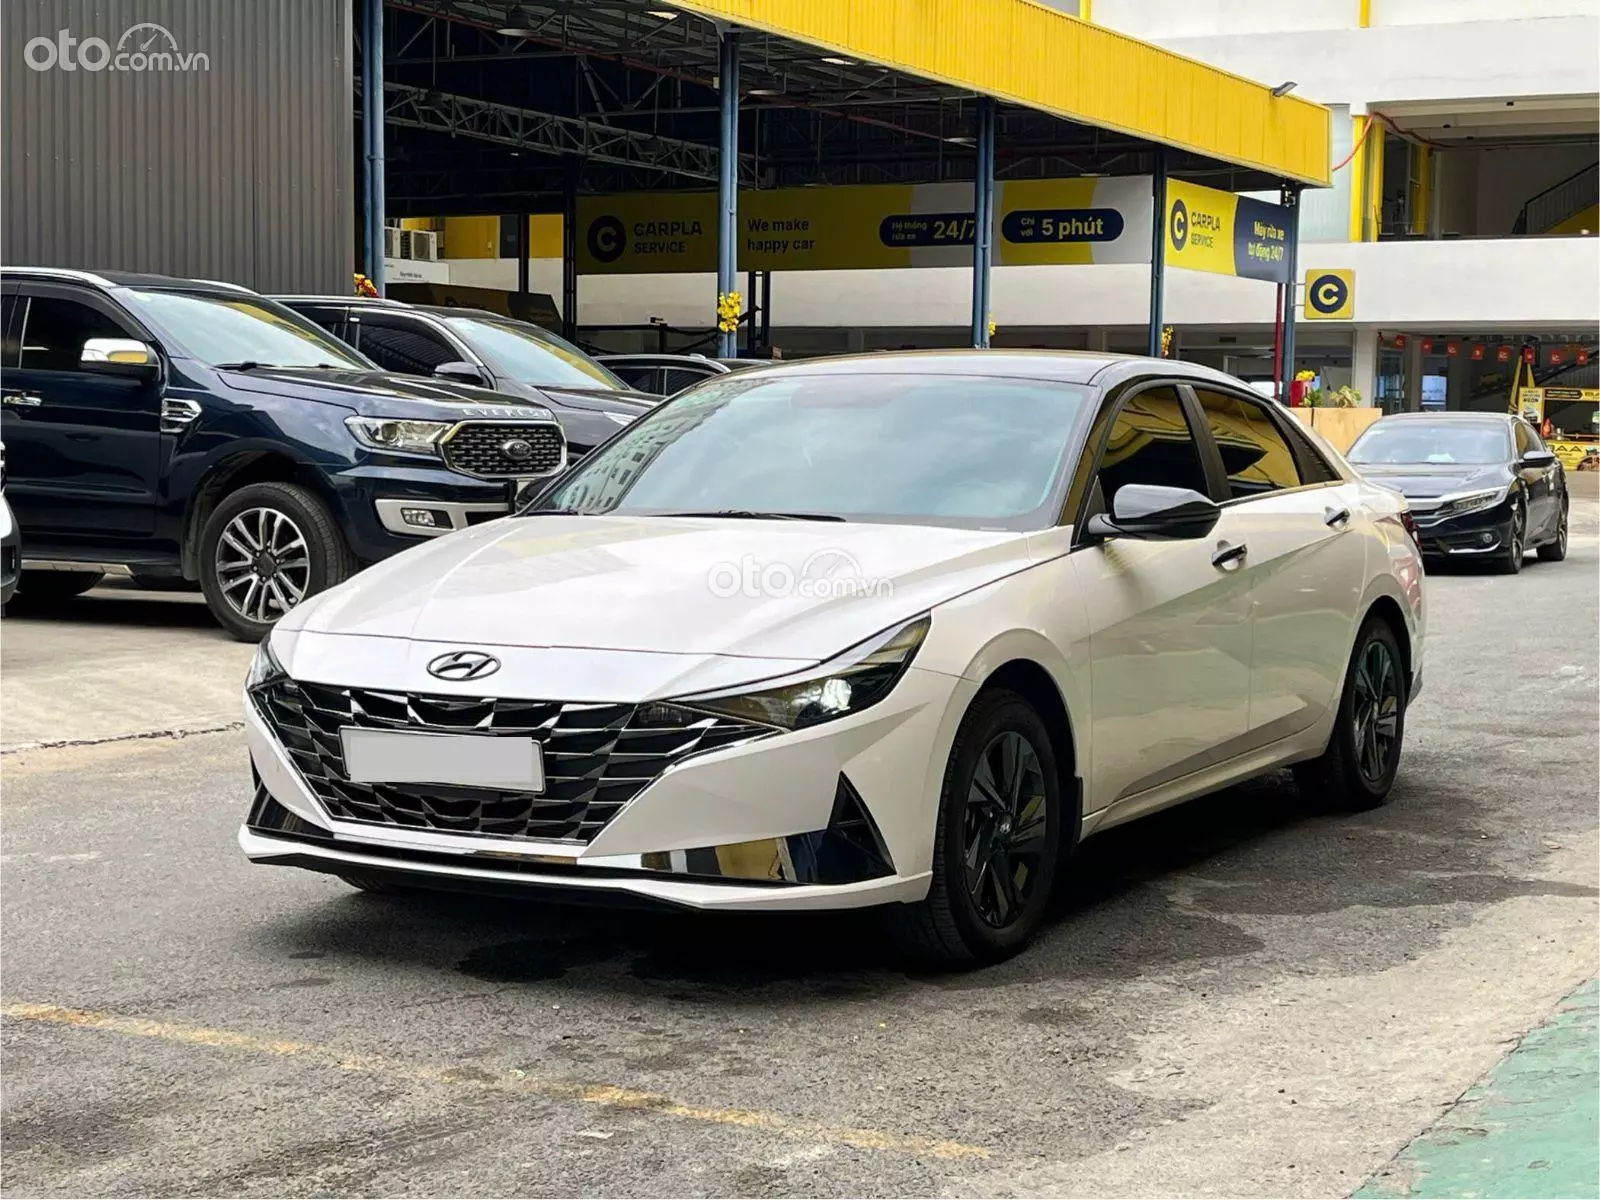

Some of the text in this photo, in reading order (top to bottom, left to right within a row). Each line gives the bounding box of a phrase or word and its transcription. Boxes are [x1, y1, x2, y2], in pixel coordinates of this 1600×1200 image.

[633, 221, 702, 237] CARPLA
[748, 219, 809, 231] We make
[1041, 216, 1104, 240] 5 phút
[1191, 212, 1221, 232] CARPLA
[1190, 233, 1214, 248] SERVICE
[1277, 229, 1285, 241] xe
[633, 242, 687, 253] SERVICE
[747, 238, 815, 253] happy car
[1270, 247, 1284, 262] 24/7
[462, 408, 552, 418] EVEREST
